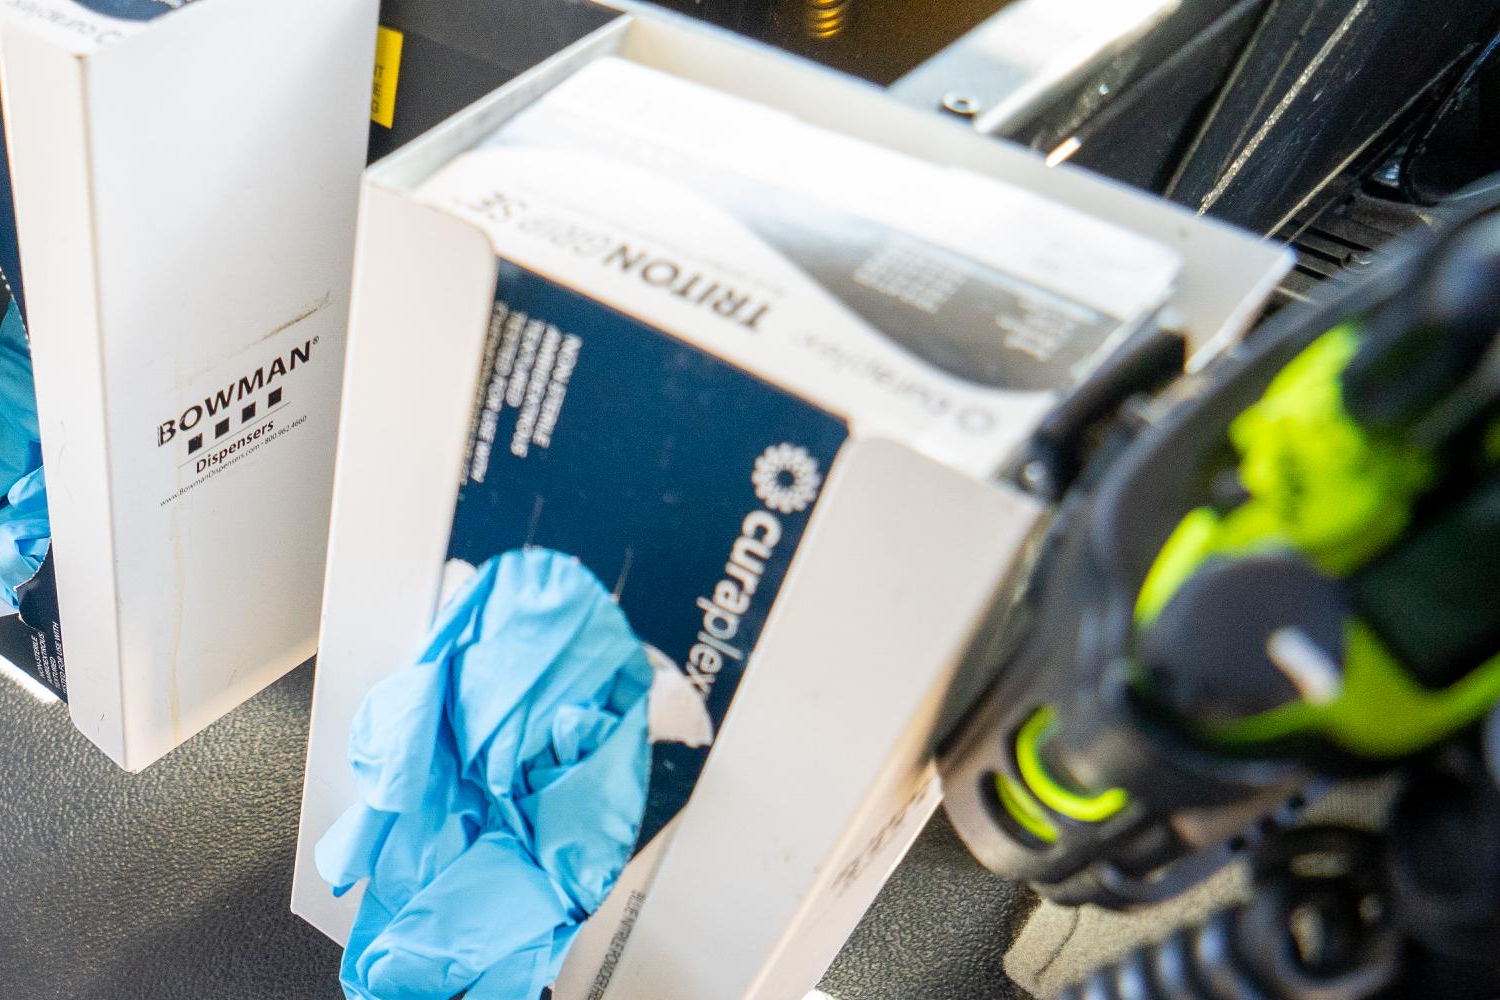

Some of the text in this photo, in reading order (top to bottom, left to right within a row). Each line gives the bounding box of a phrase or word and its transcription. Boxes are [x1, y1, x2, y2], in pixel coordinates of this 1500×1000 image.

[601, 243, 770, 333] TRITON
[195, 420, 275, 475] Dispensers
[685, 509, 783, 698] curaplex
[52, 621, 61, 642] WITH
[57, 656, 66, 673] FOR
[595, 949, 621, 988] POWDER
